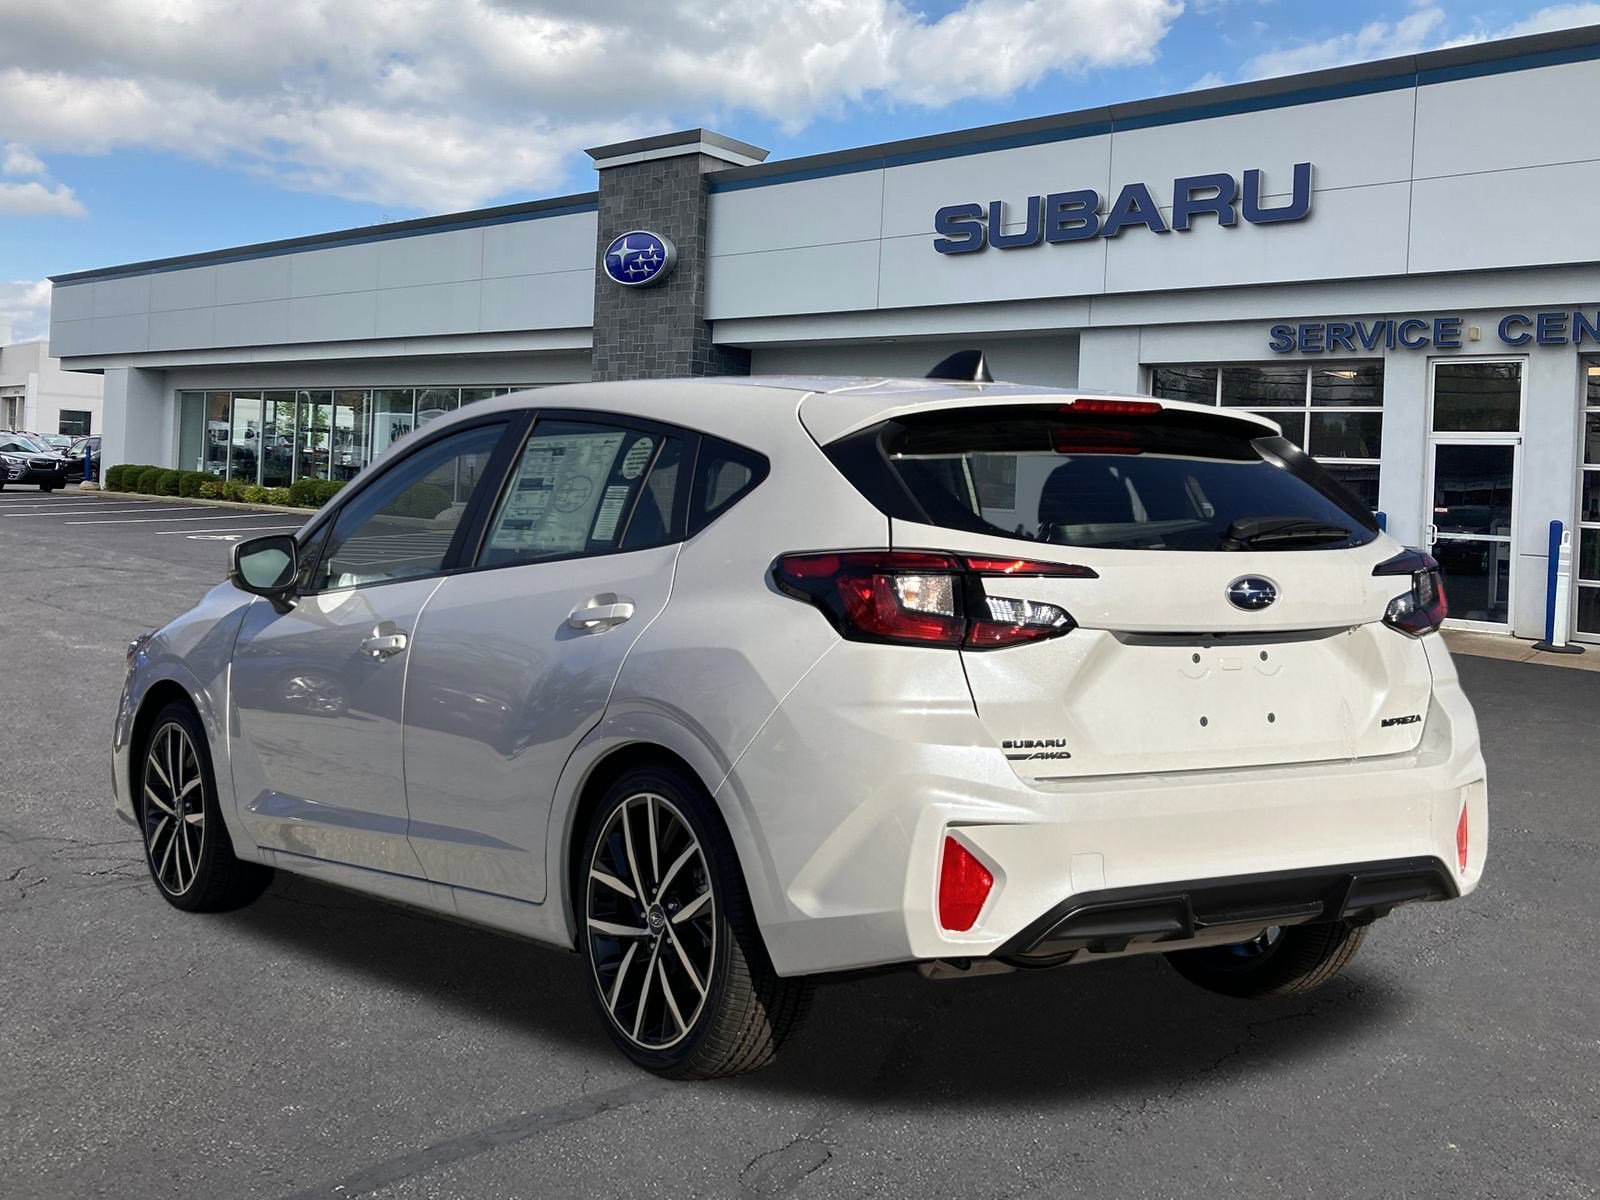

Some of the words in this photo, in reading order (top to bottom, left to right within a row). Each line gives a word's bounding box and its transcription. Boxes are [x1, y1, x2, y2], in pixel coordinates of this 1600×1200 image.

[933, 162, 1313, 255] SUBARU
[1268, 317, 1463, 352] SERVICE
[1497, 311, 1600, 345] CEN
[1381, 714, 1422, 728] IMPREZA
[1002, 738, 1067, 749] SUBARU
[1028, 751, 1072, 761] AWD
